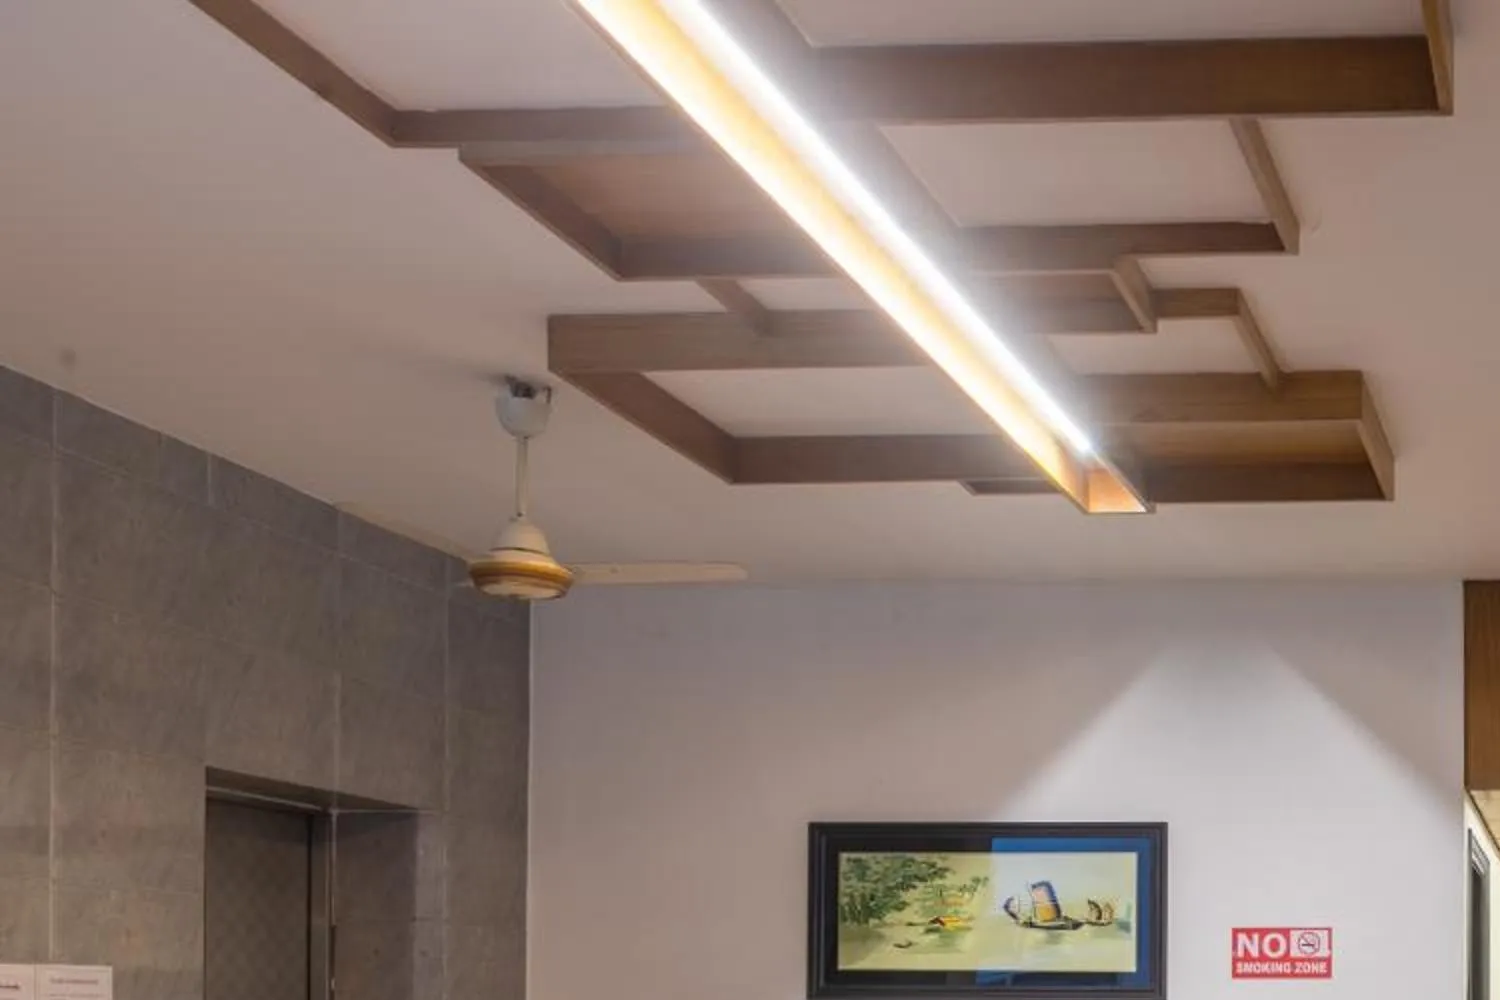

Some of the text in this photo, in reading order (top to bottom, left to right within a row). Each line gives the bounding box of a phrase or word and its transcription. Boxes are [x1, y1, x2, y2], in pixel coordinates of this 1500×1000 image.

[1237, 932, 1287, 958] NO
[1236, 961, 1327, 974] SMOKING ZONE
